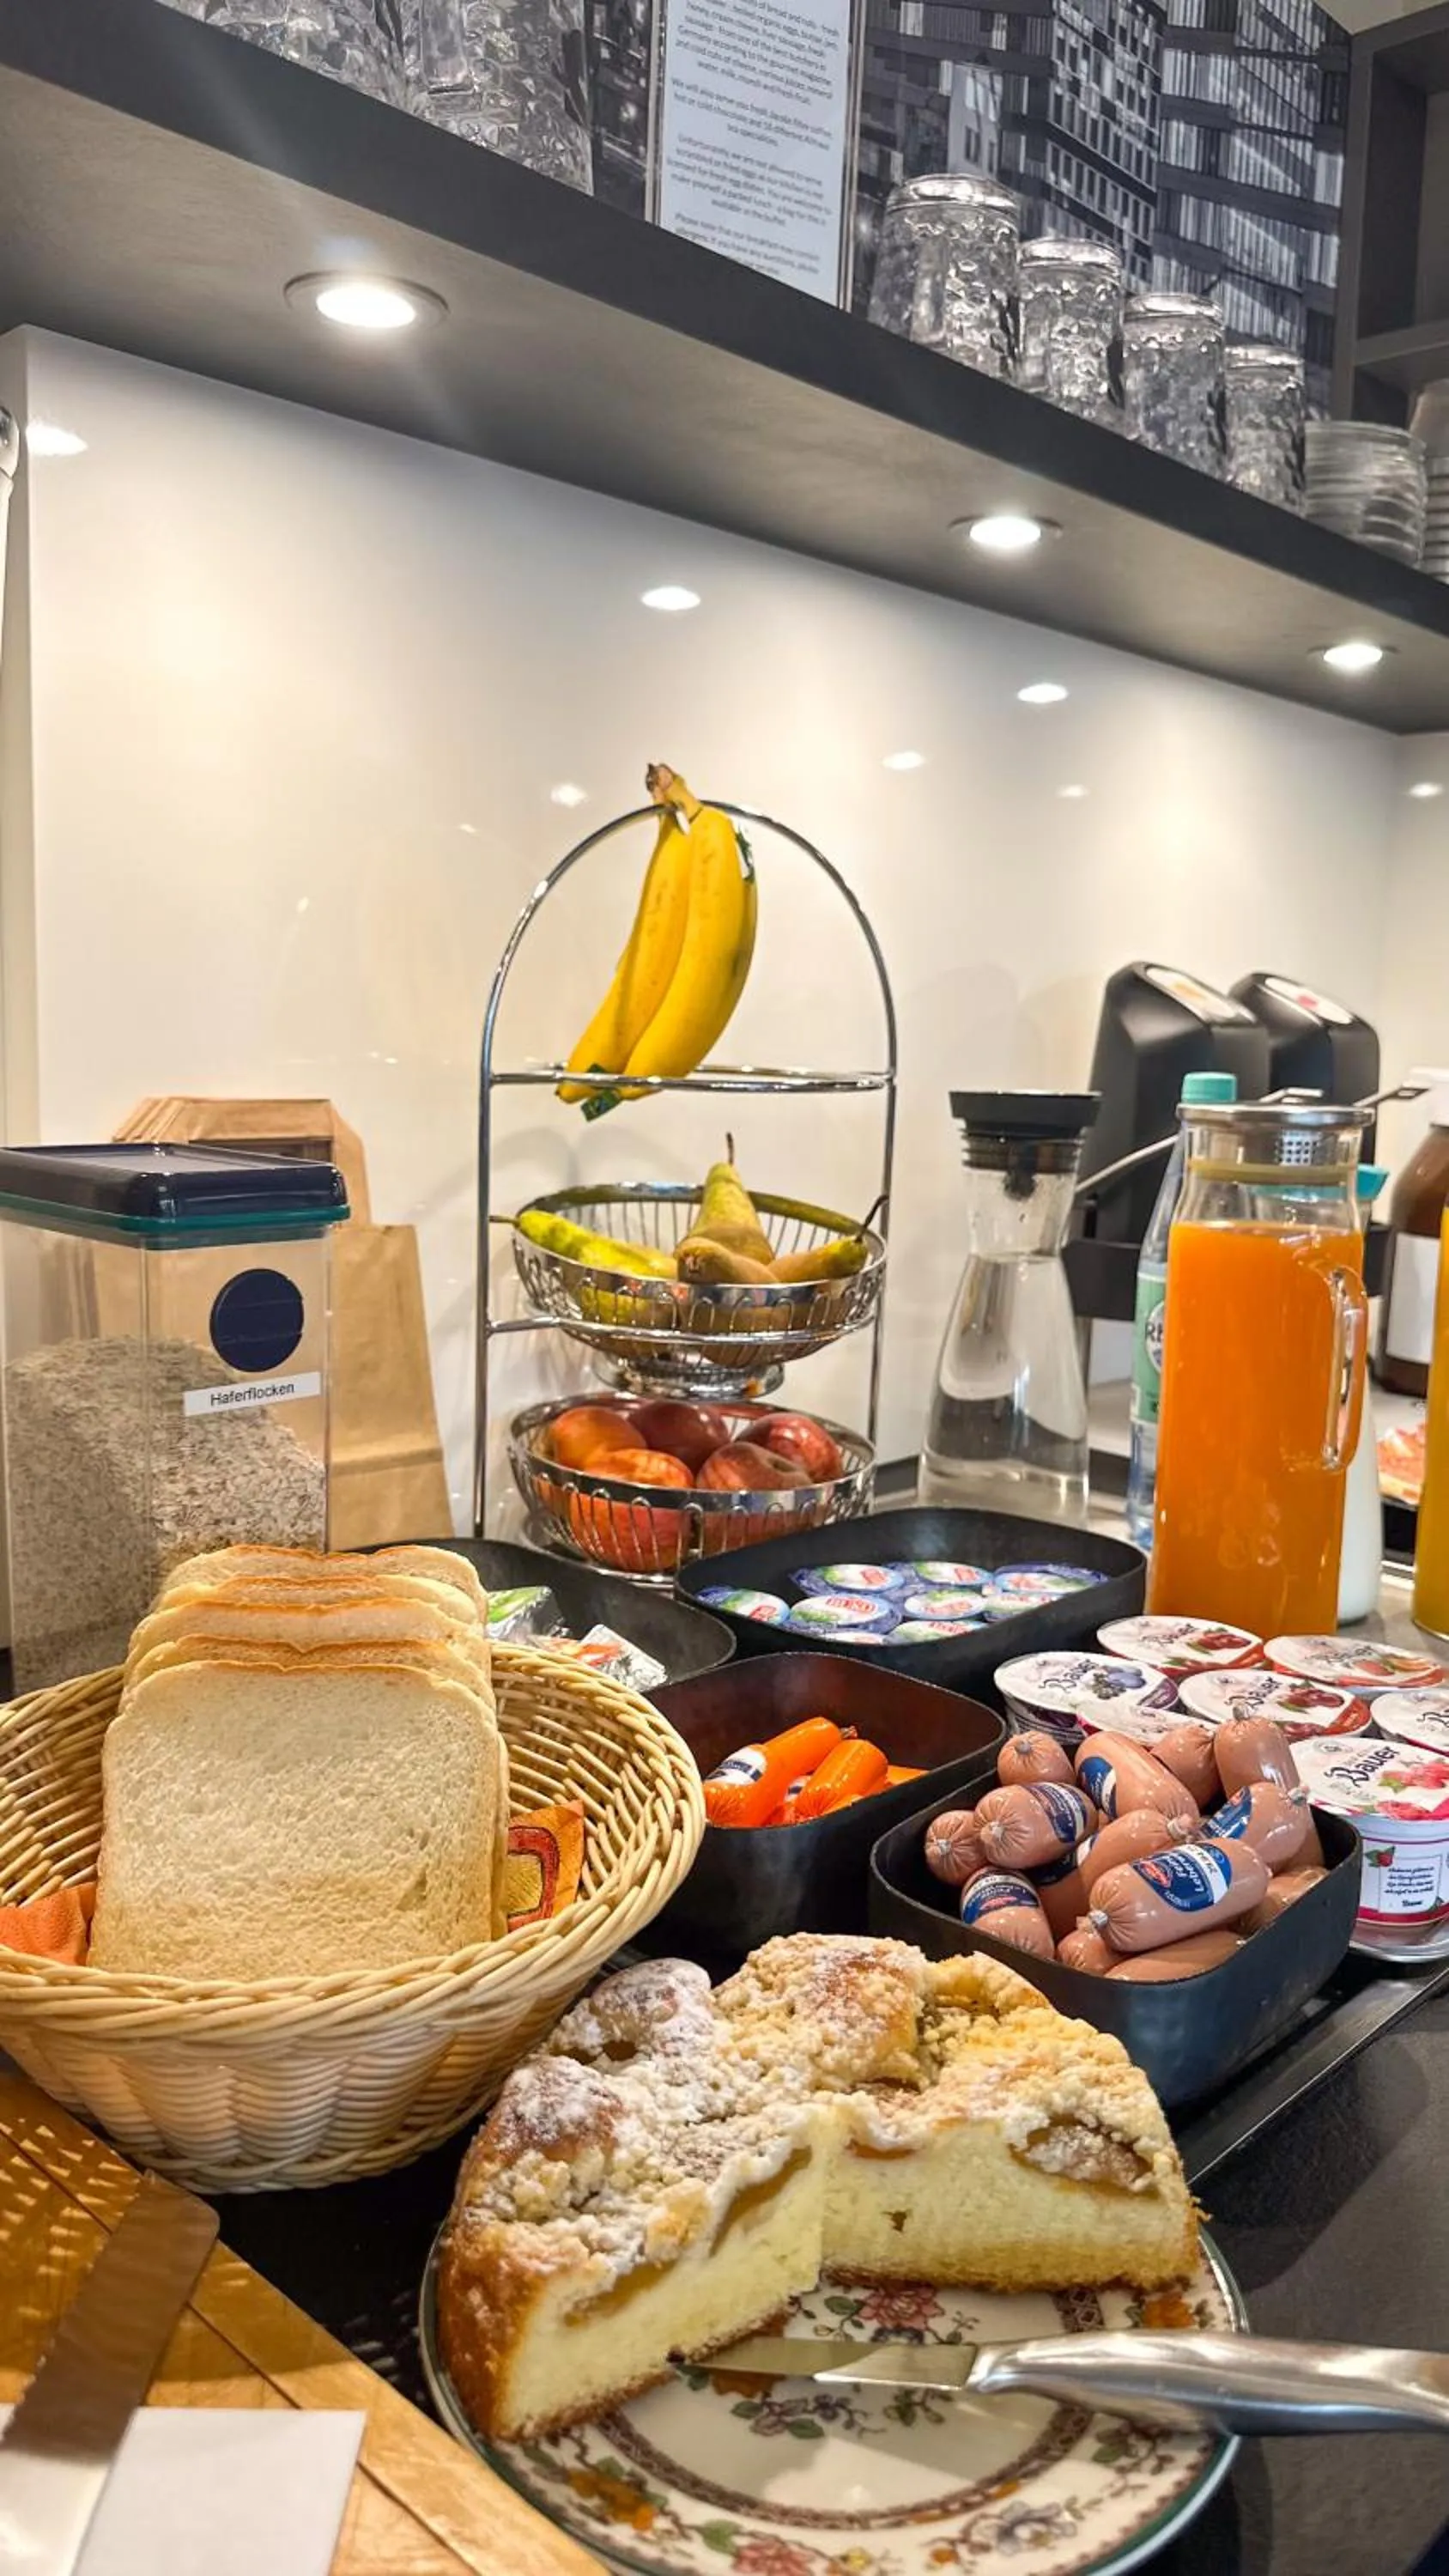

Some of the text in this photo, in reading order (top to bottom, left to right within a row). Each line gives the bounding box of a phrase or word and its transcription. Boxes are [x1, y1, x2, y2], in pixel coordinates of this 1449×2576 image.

[210, 1383, 294, 1406] Haferflocken
[1039, 1658, 1099, 1694] Bauer
[1224, 1676, 1282, 1710] Bauer
[1323, 1746, 1400, 1788] Bauer
